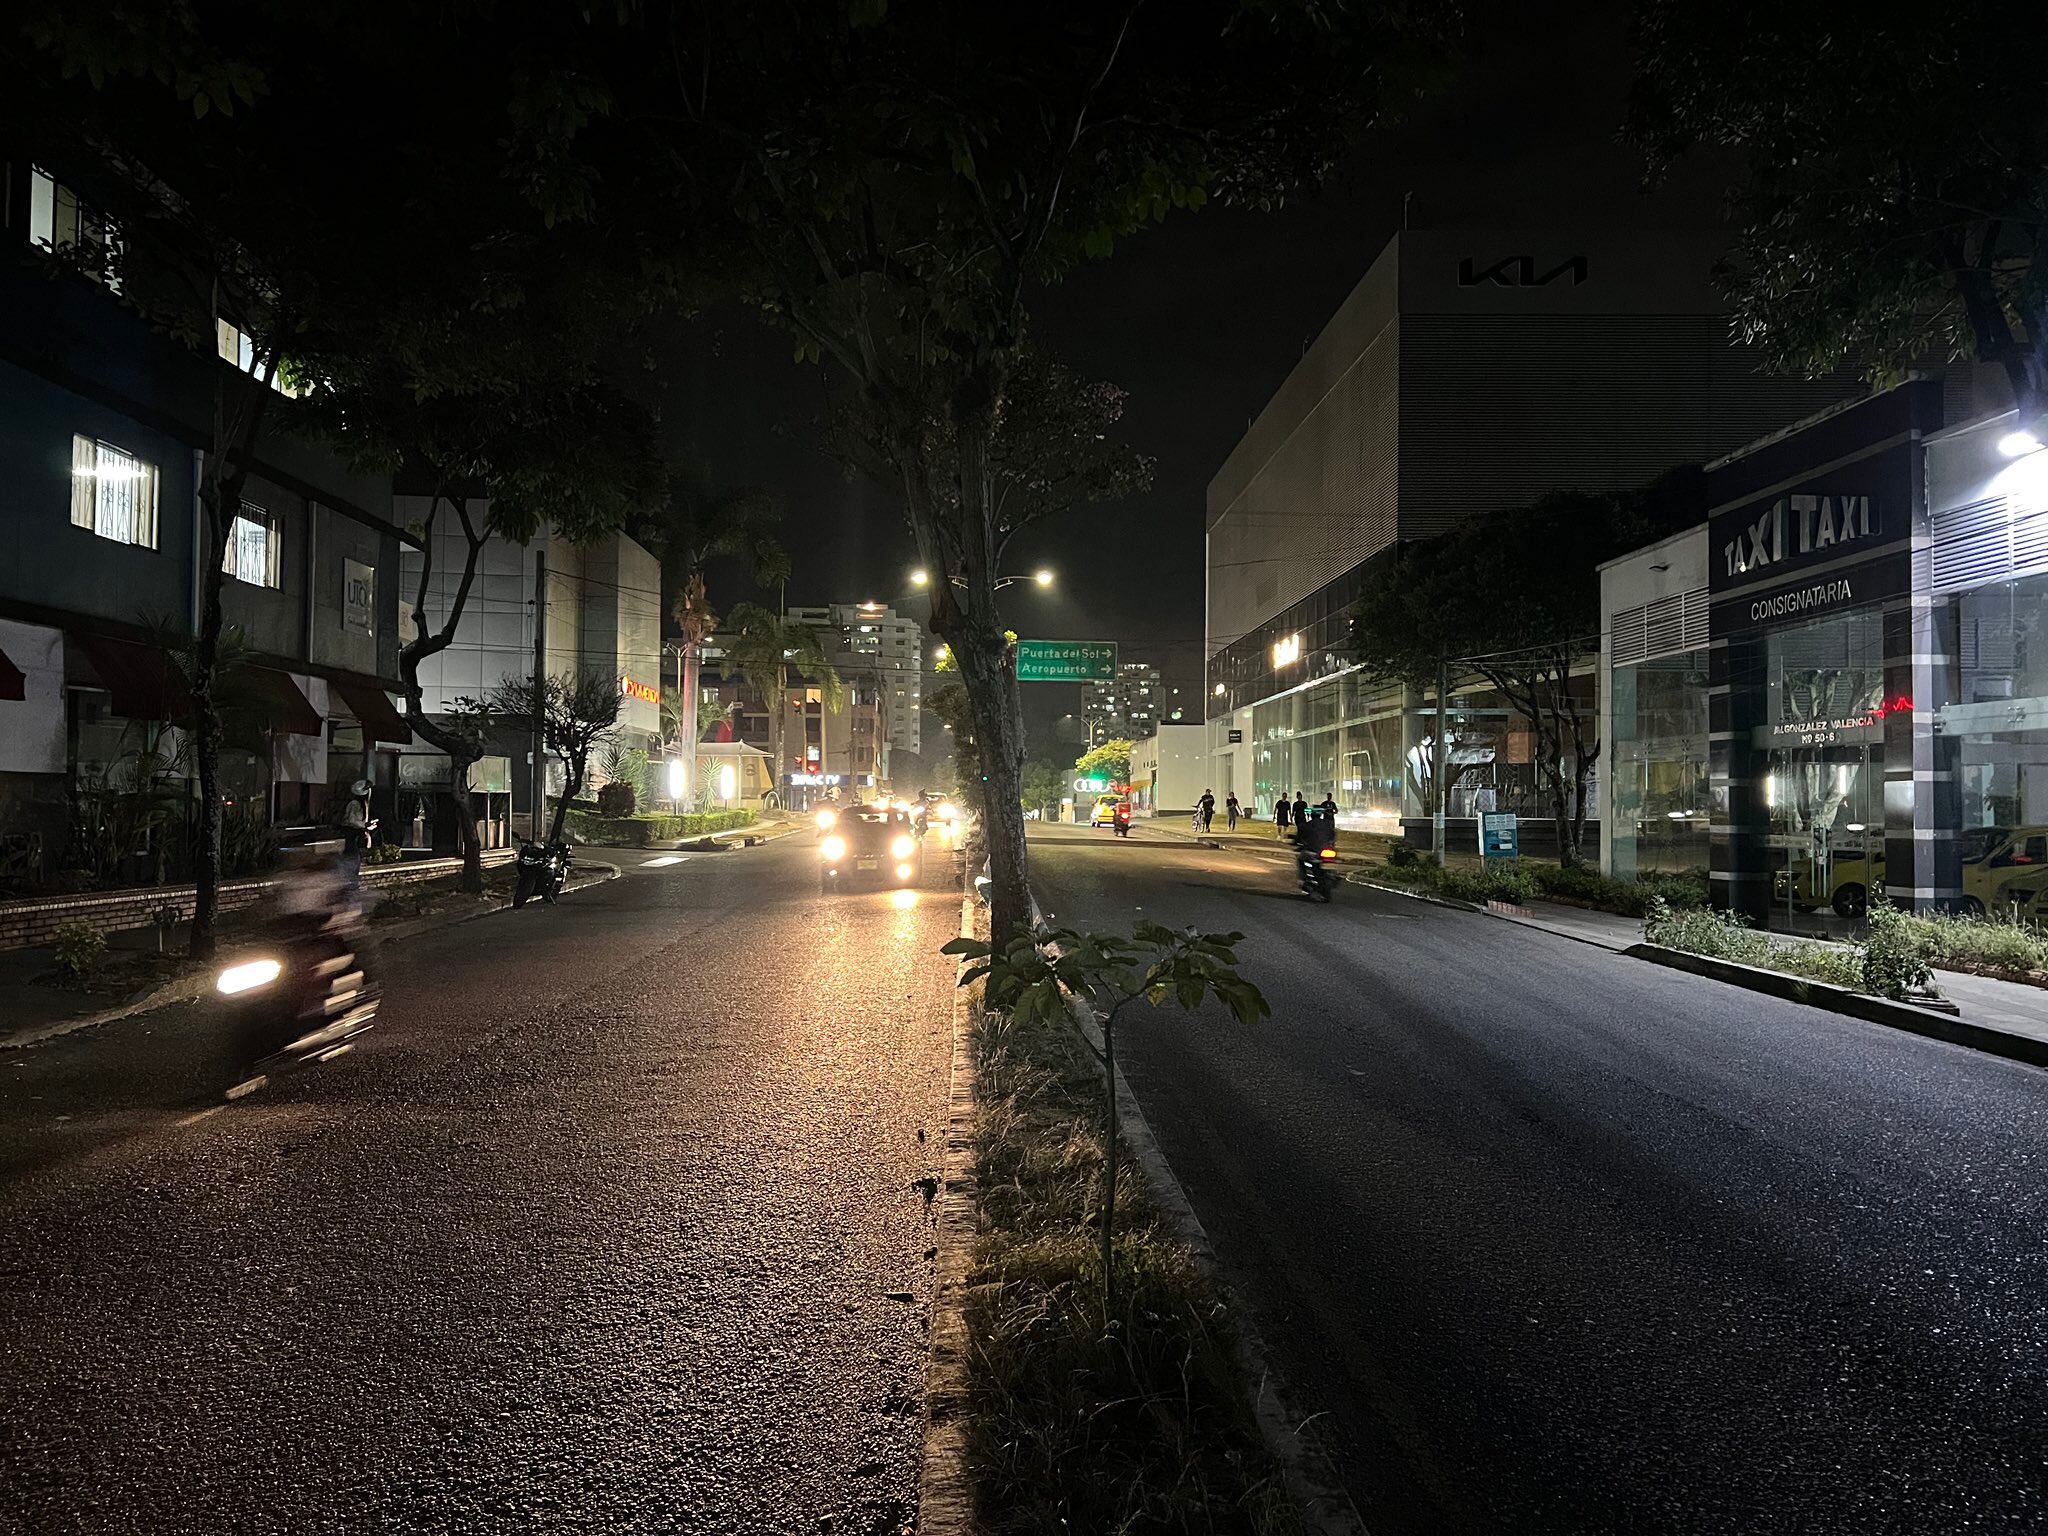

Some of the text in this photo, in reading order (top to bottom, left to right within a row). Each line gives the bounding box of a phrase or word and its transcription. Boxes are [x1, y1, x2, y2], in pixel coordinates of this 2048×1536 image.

[1458, 256, 1587, 287] KIA
[1724, 494, 1871, 577] TAXI TAXI
[1751, 579, 1852, 621] CONSIGNATARIA
[1021, 647, 1100, 659] Puerta del Sol
[1021, 662, 1087, 676] Aeropuerto
[1830, 716, 1874, 729] VALENCIA
